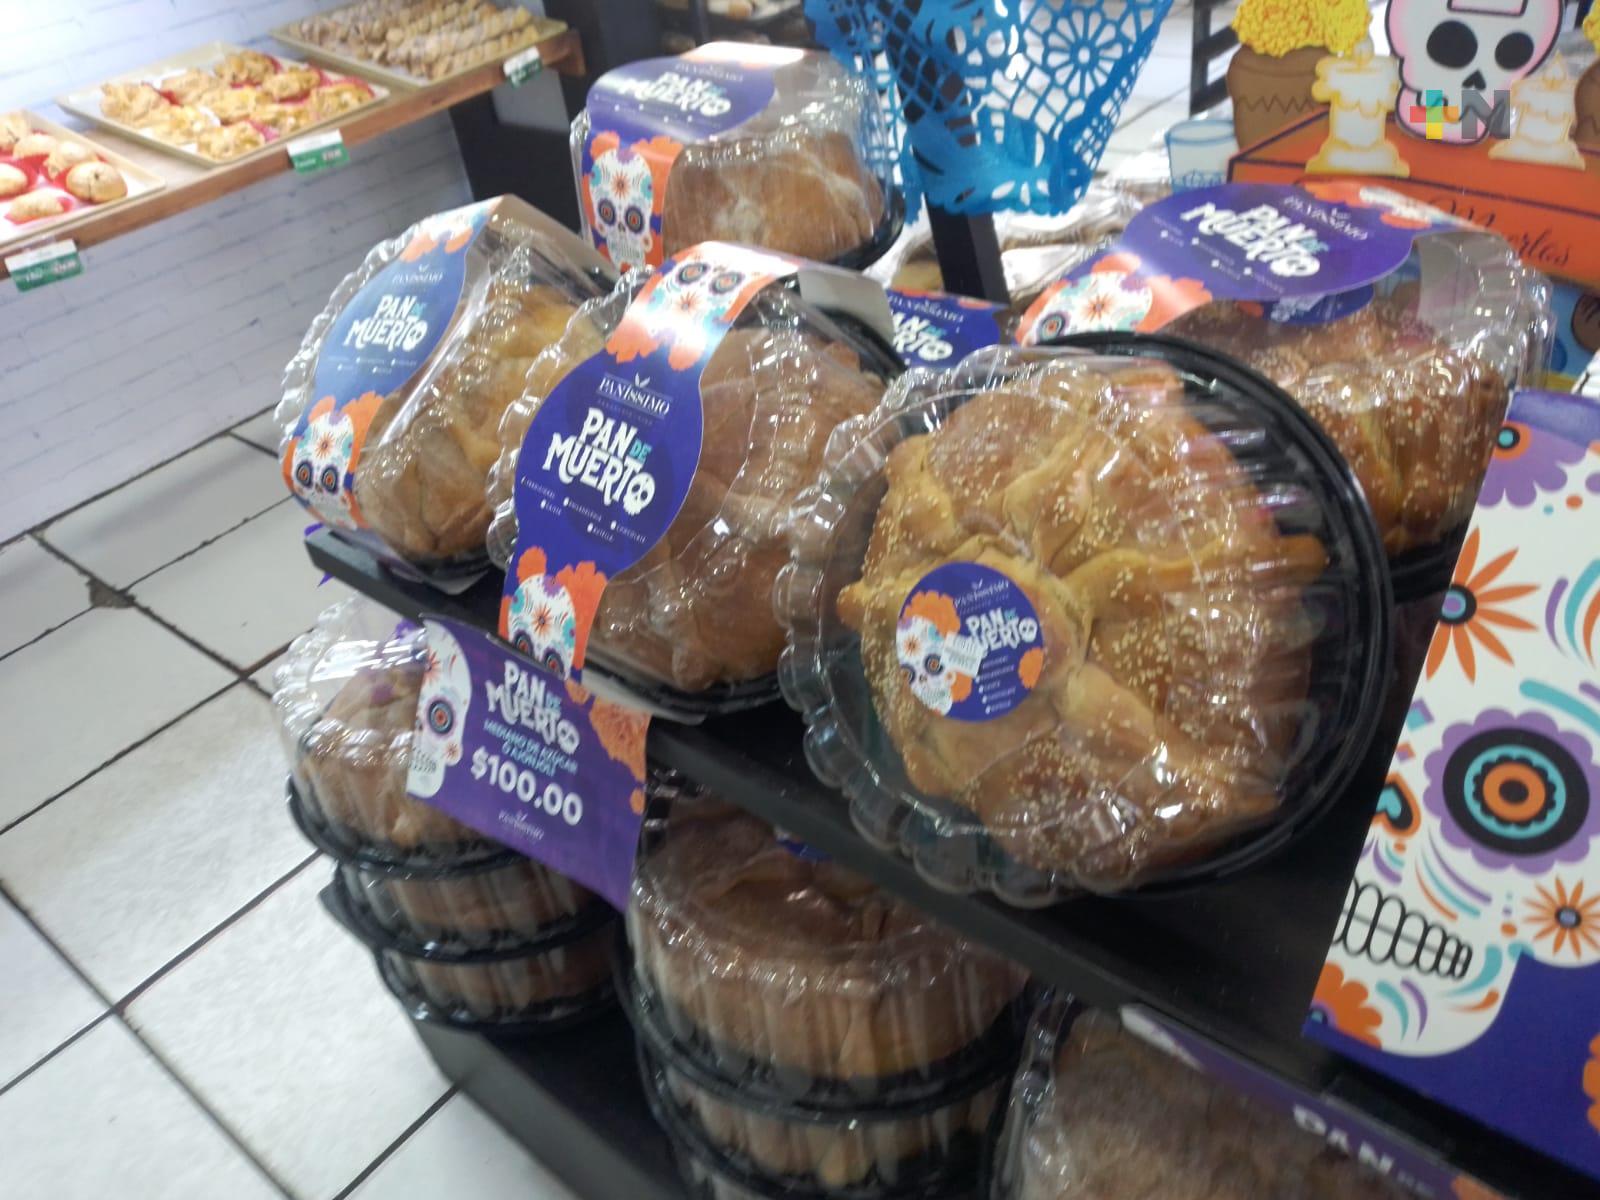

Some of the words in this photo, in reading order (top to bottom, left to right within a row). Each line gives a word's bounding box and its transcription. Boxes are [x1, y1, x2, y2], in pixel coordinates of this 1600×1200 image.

[655, 72, 711, 96] PAN
[1180, 202, 1320, 277] MUERTO
[1238, 204, 1317, 243] PAN
[343, 314, 428, 352] MUERTO
[374, 294, 417, 320] PAN
[579, 407, 638, 459] PAN
[629, 437, 653, 464] DE
[542, 431, 656, 516] MUERTO
[504, 660, 546, 709] PAN
[485, 680, 580, 754] MUERTO
[471, 746, 583, 826] $100.00
